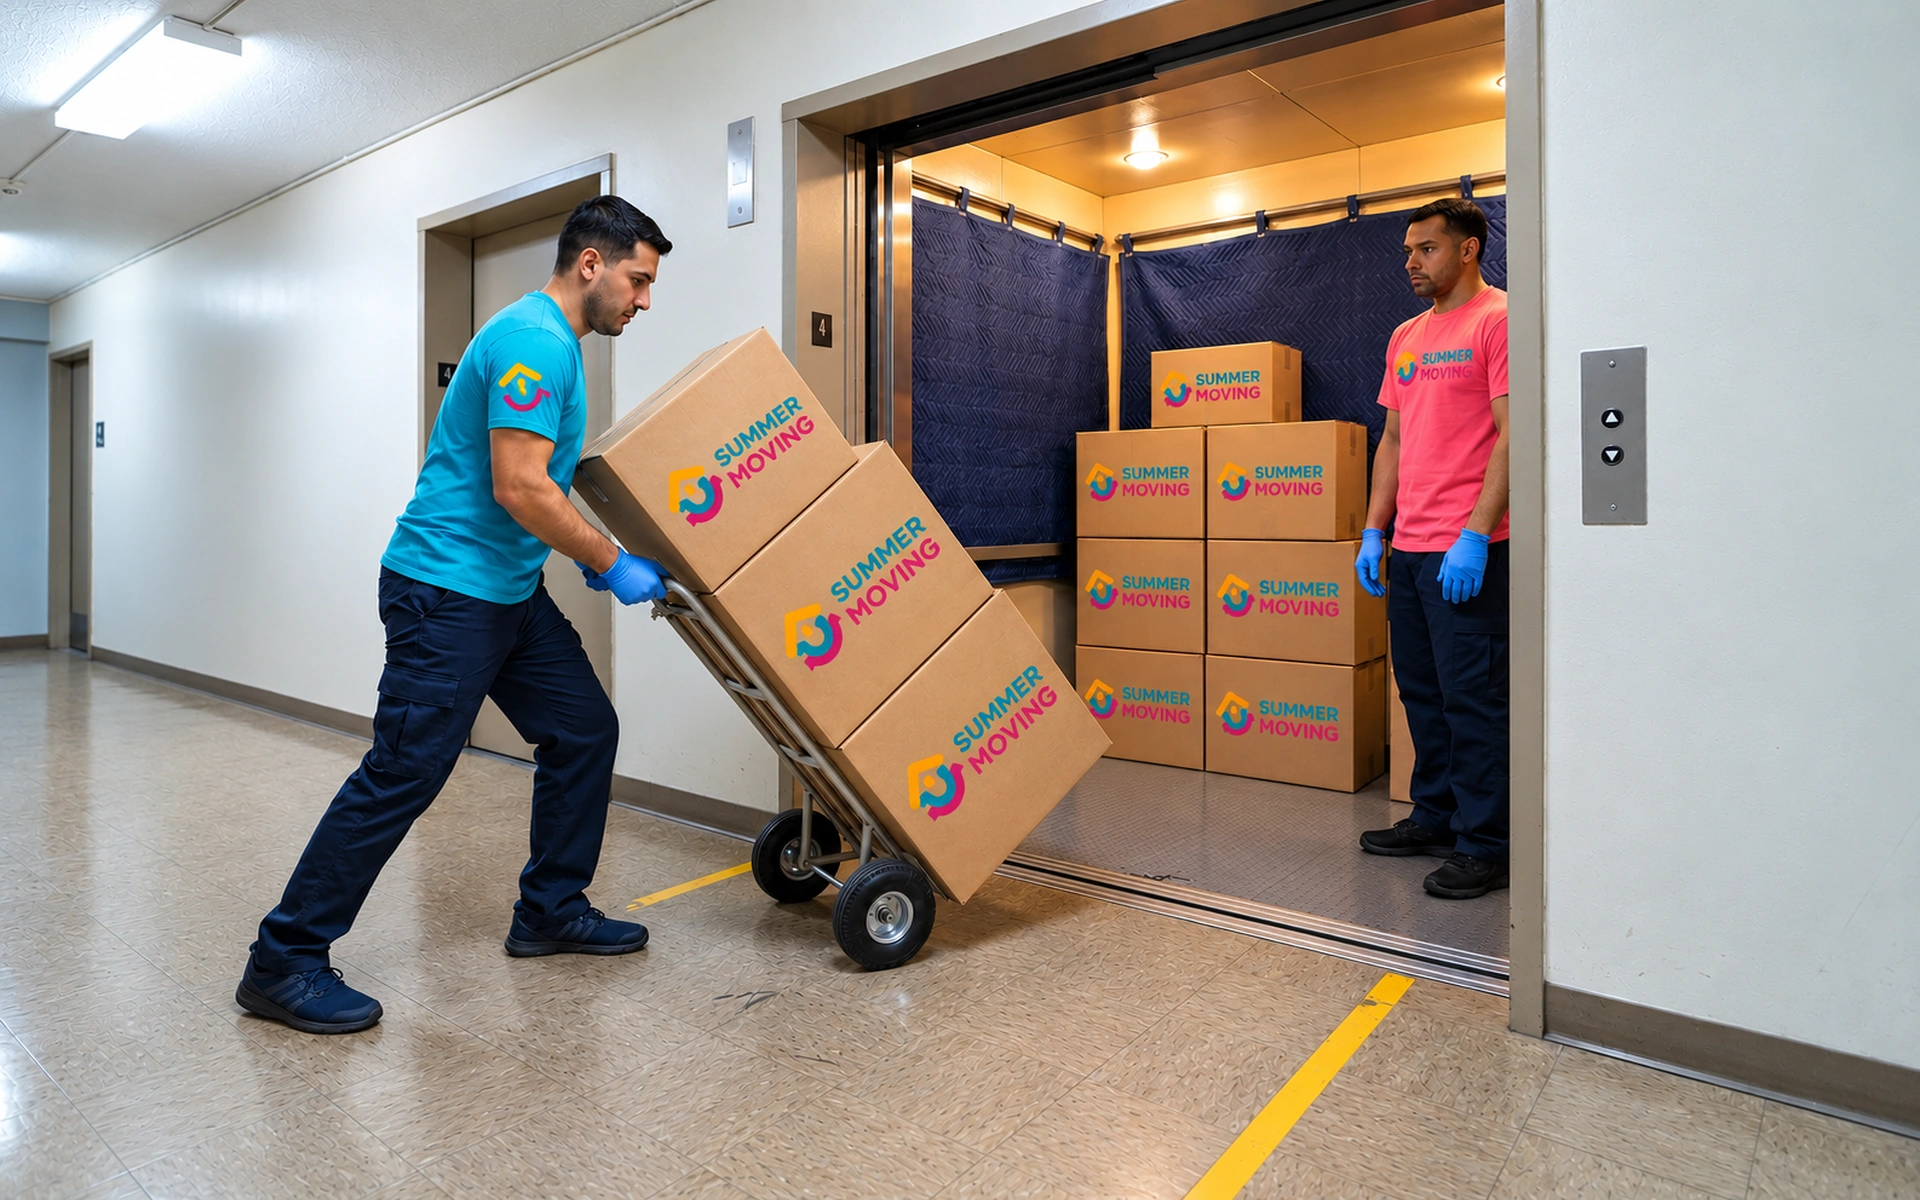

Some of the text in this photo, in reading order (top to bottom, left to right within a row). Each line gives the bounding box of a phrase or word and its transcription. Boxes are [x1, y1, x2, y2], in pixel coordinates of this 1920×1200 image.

[818, 318, 827, 336] 4
[1421, 348, 1474, 365] SUMMER
[443, 367, 452, 379] 4
[1196, 370, 1261, 386] SUMMER
[1419, 364, 1474, 381] MOVING
[1195, 386, 1261, 401] MOVING
[714, 396, 803, 467] SUMMER
[726, 415, 815, 488] MOVING
[1122, 466, 1190, 480] SUMMER
[1255, 465, 1324, 479] SUMMER
[1121, 483, 1190, 497] MOVING
[1255, 482, 1324, 496] MOVING
[830, 516, 927, 603] SUMMER
[845, 537, 941, 625] MOVING
[1122, 575, 1190, 591] SUMMER
[1259, 579, 1339, 598] SUMMER
[1121, 592, 1191, 610] MOVING
[1259, 598, 1340, 618] MOVING
[1122, 686, 1190, 706] SUMMER
[953, 665, 1043, 754] SUMMER
[1121, 703, 1191, 724] MOVING
[1259, 699, 1339, 722] SUMMER
[967, 685, 1058, 776] MOVING
[1259, 718, 1340, 742] MOVING
